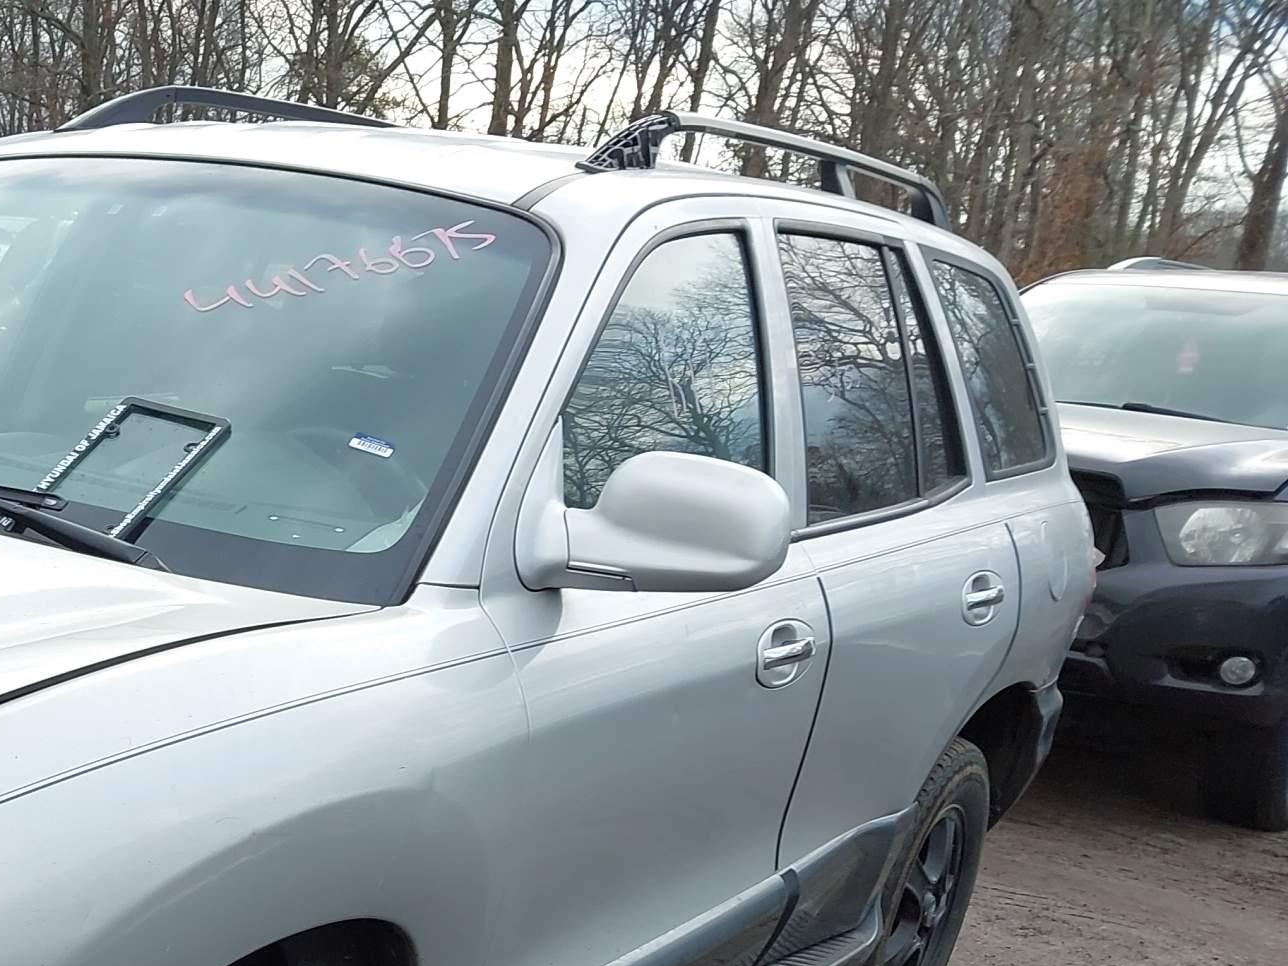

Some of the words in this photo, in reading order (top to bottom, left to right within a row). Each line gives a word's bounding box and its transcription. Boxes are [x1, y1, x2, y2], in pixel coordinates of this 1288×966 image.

[36, 451, 80, 490] HYUNDAI
[74, 439, 91, 452] OF
[88, 404, 128, 440] JAMAICA
